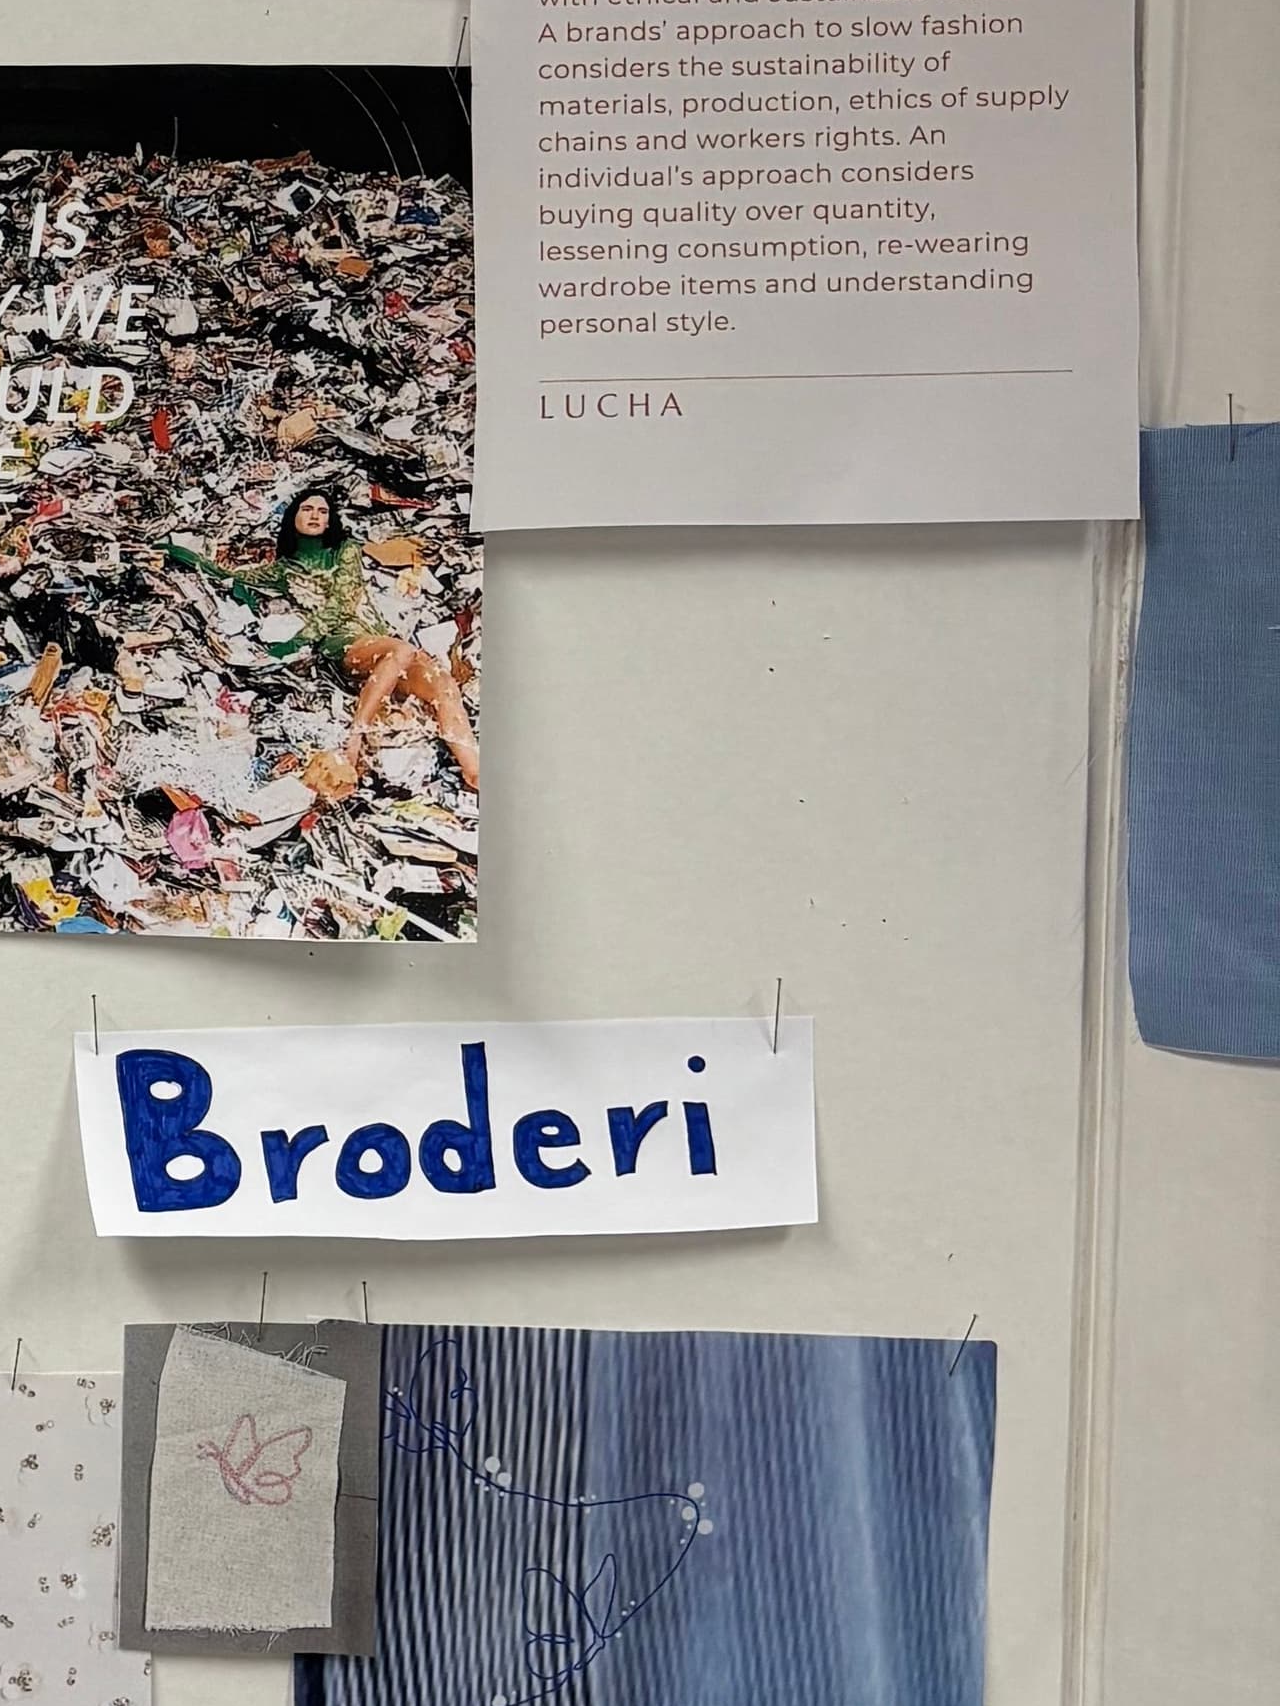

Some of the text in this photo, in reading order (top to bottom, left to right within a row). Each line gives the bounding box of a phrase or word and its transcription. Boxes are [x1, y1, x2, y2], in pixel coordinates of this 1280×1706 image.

[538, 22, 558, 44] A
[676, 17, 805, 46] approach
[814, 19, 843, 39] to
[850, 15, 913, 38] slow
[921, 12, 1023, 37] fashion
[538, 50, 952, 81] considers the sustainability of
[540, 84, 1070, 120] materials, production, ethics of supply
[539, 160, 975, 192] individual's approach considers
[30, 201, 88, 259] IS
[540, 197, 936, 230] buying quality over quantity,
[540, 231, 1029, 265] lessening consumption, re-wearing
[45, 282, 155, 341] WE
[541, 309, 736, 340] personal style.
[541, 392, 684, 420] LUCHA
[115, 1041, 718, 1213] Broderi
